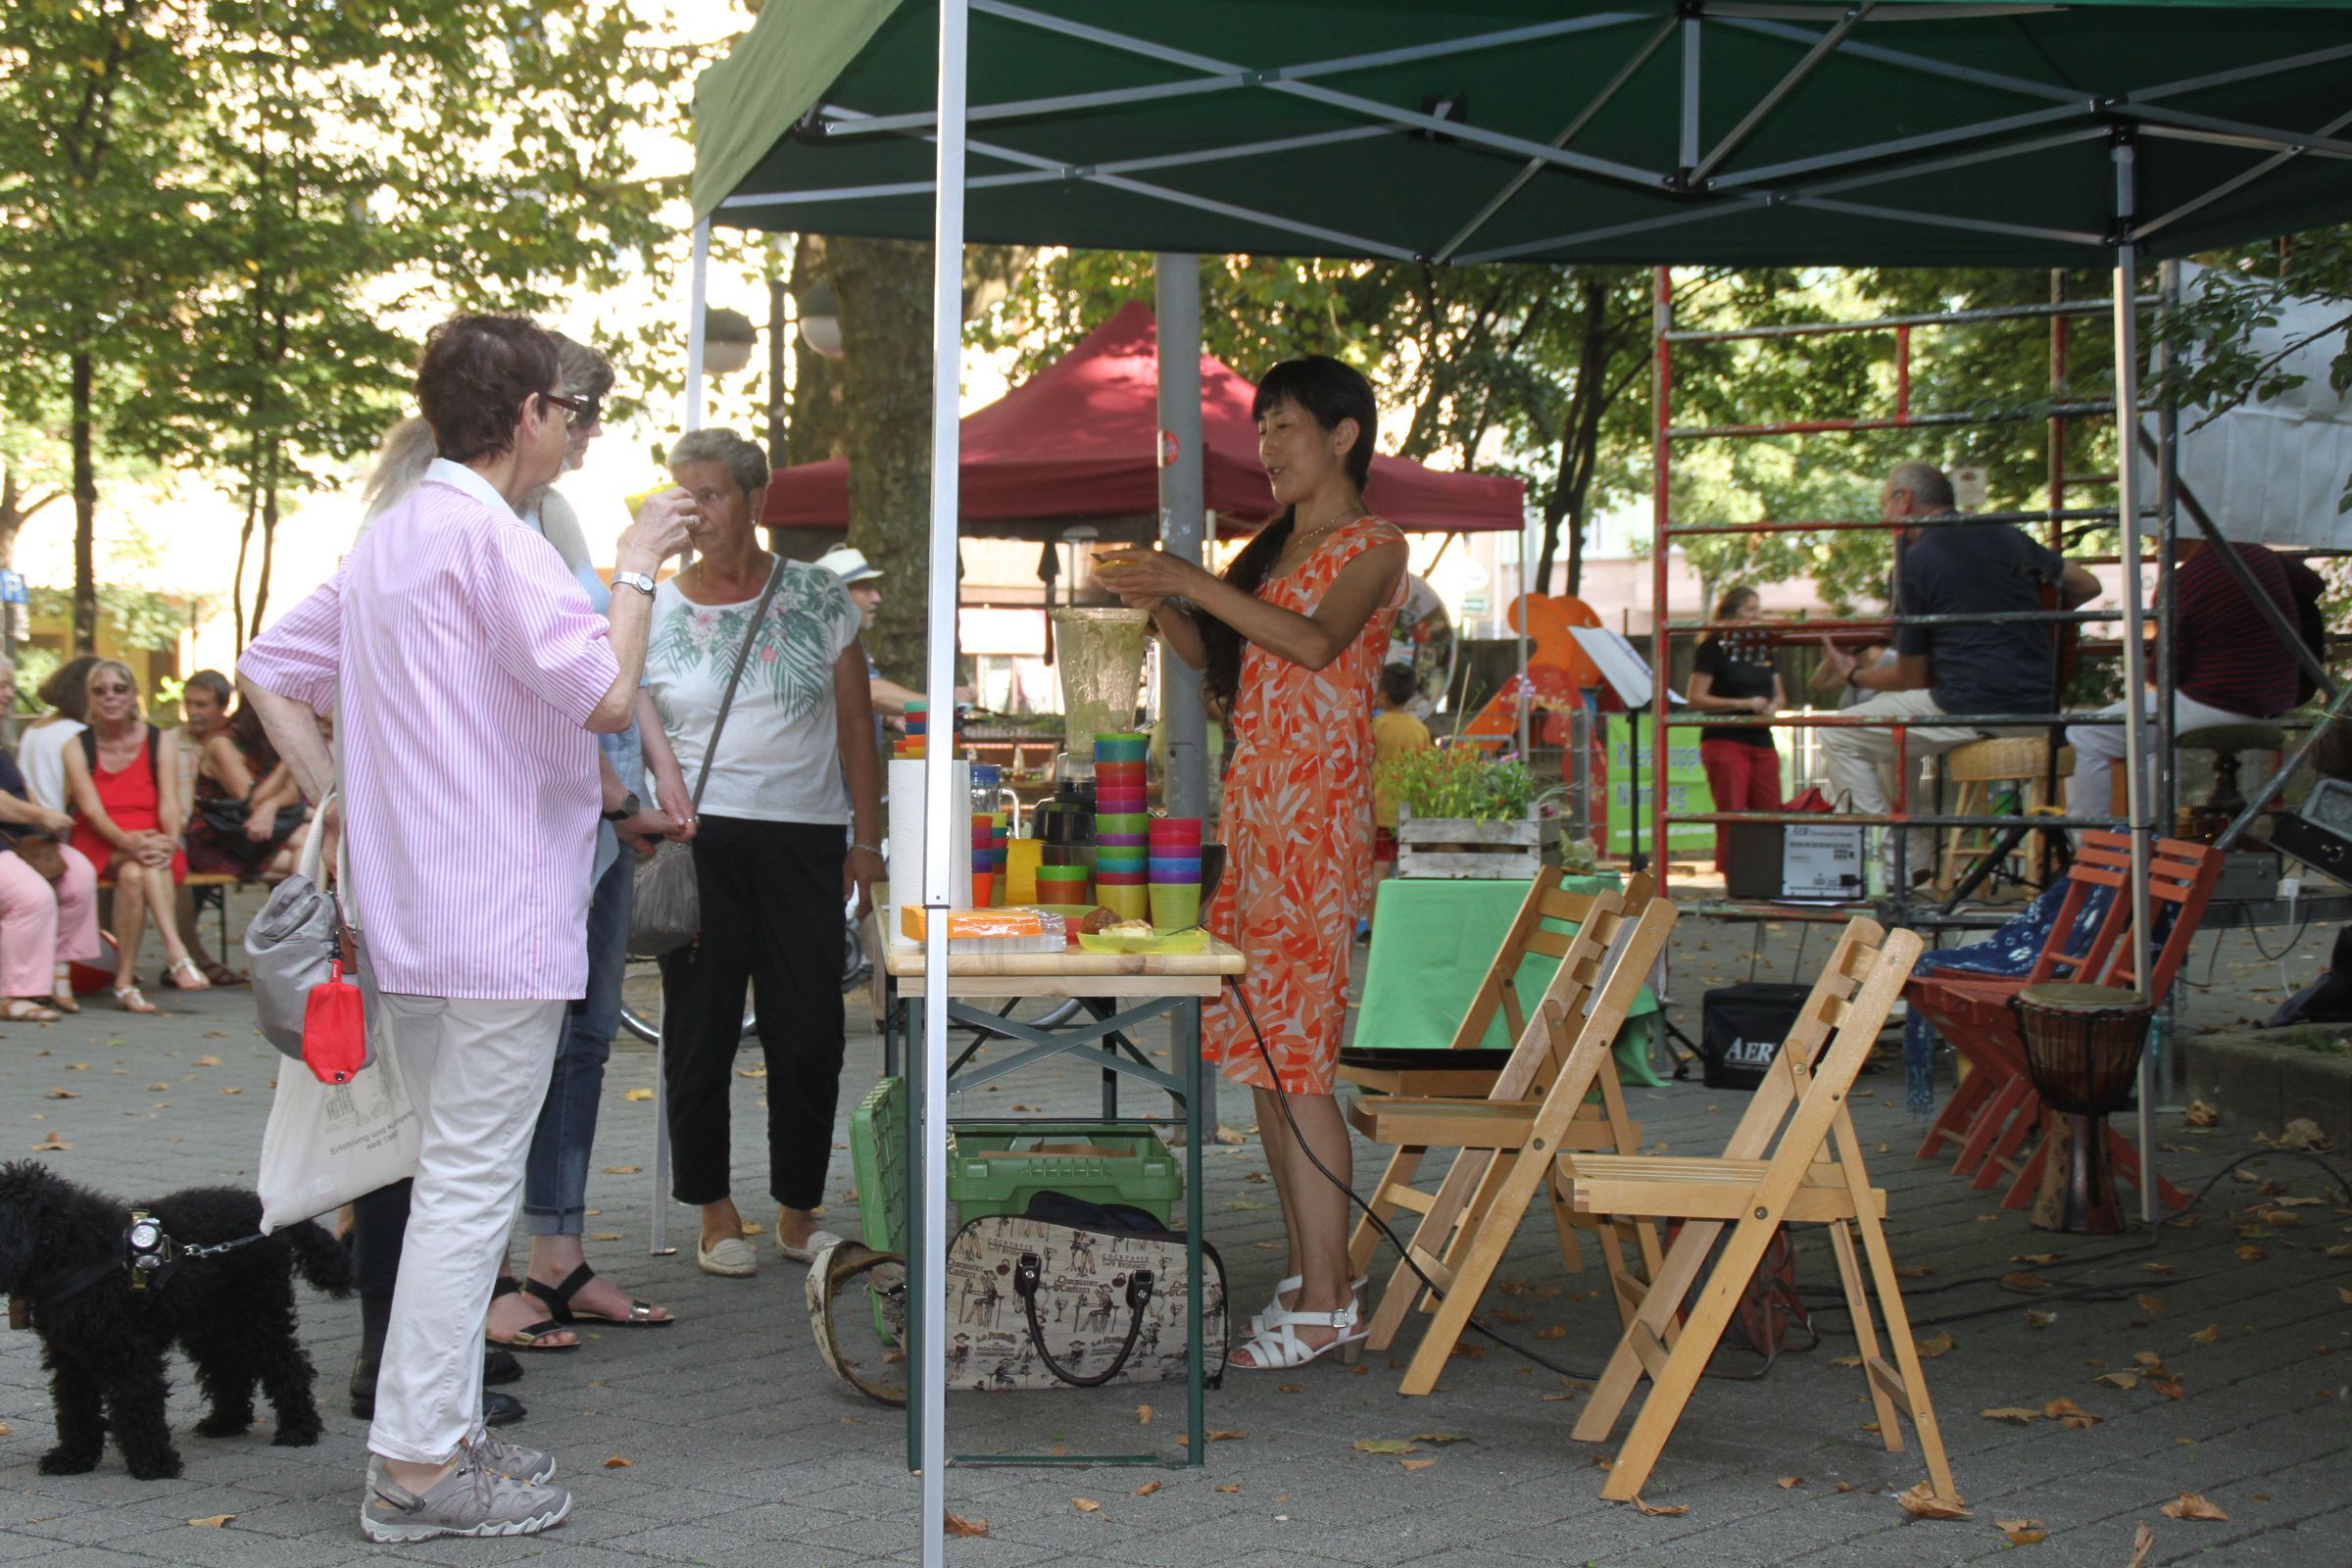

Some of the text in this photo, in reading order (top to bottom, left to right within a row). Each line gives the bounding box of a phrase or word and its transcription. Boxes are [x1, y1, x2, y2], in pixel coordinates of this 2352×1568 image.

[1724, 1037, 1775, 1062] AER
[329, 1135, 370, 1155] Erfahrung
[371, 1126, 386, 1138] und
[367, 1139, 382, 1151] seit
